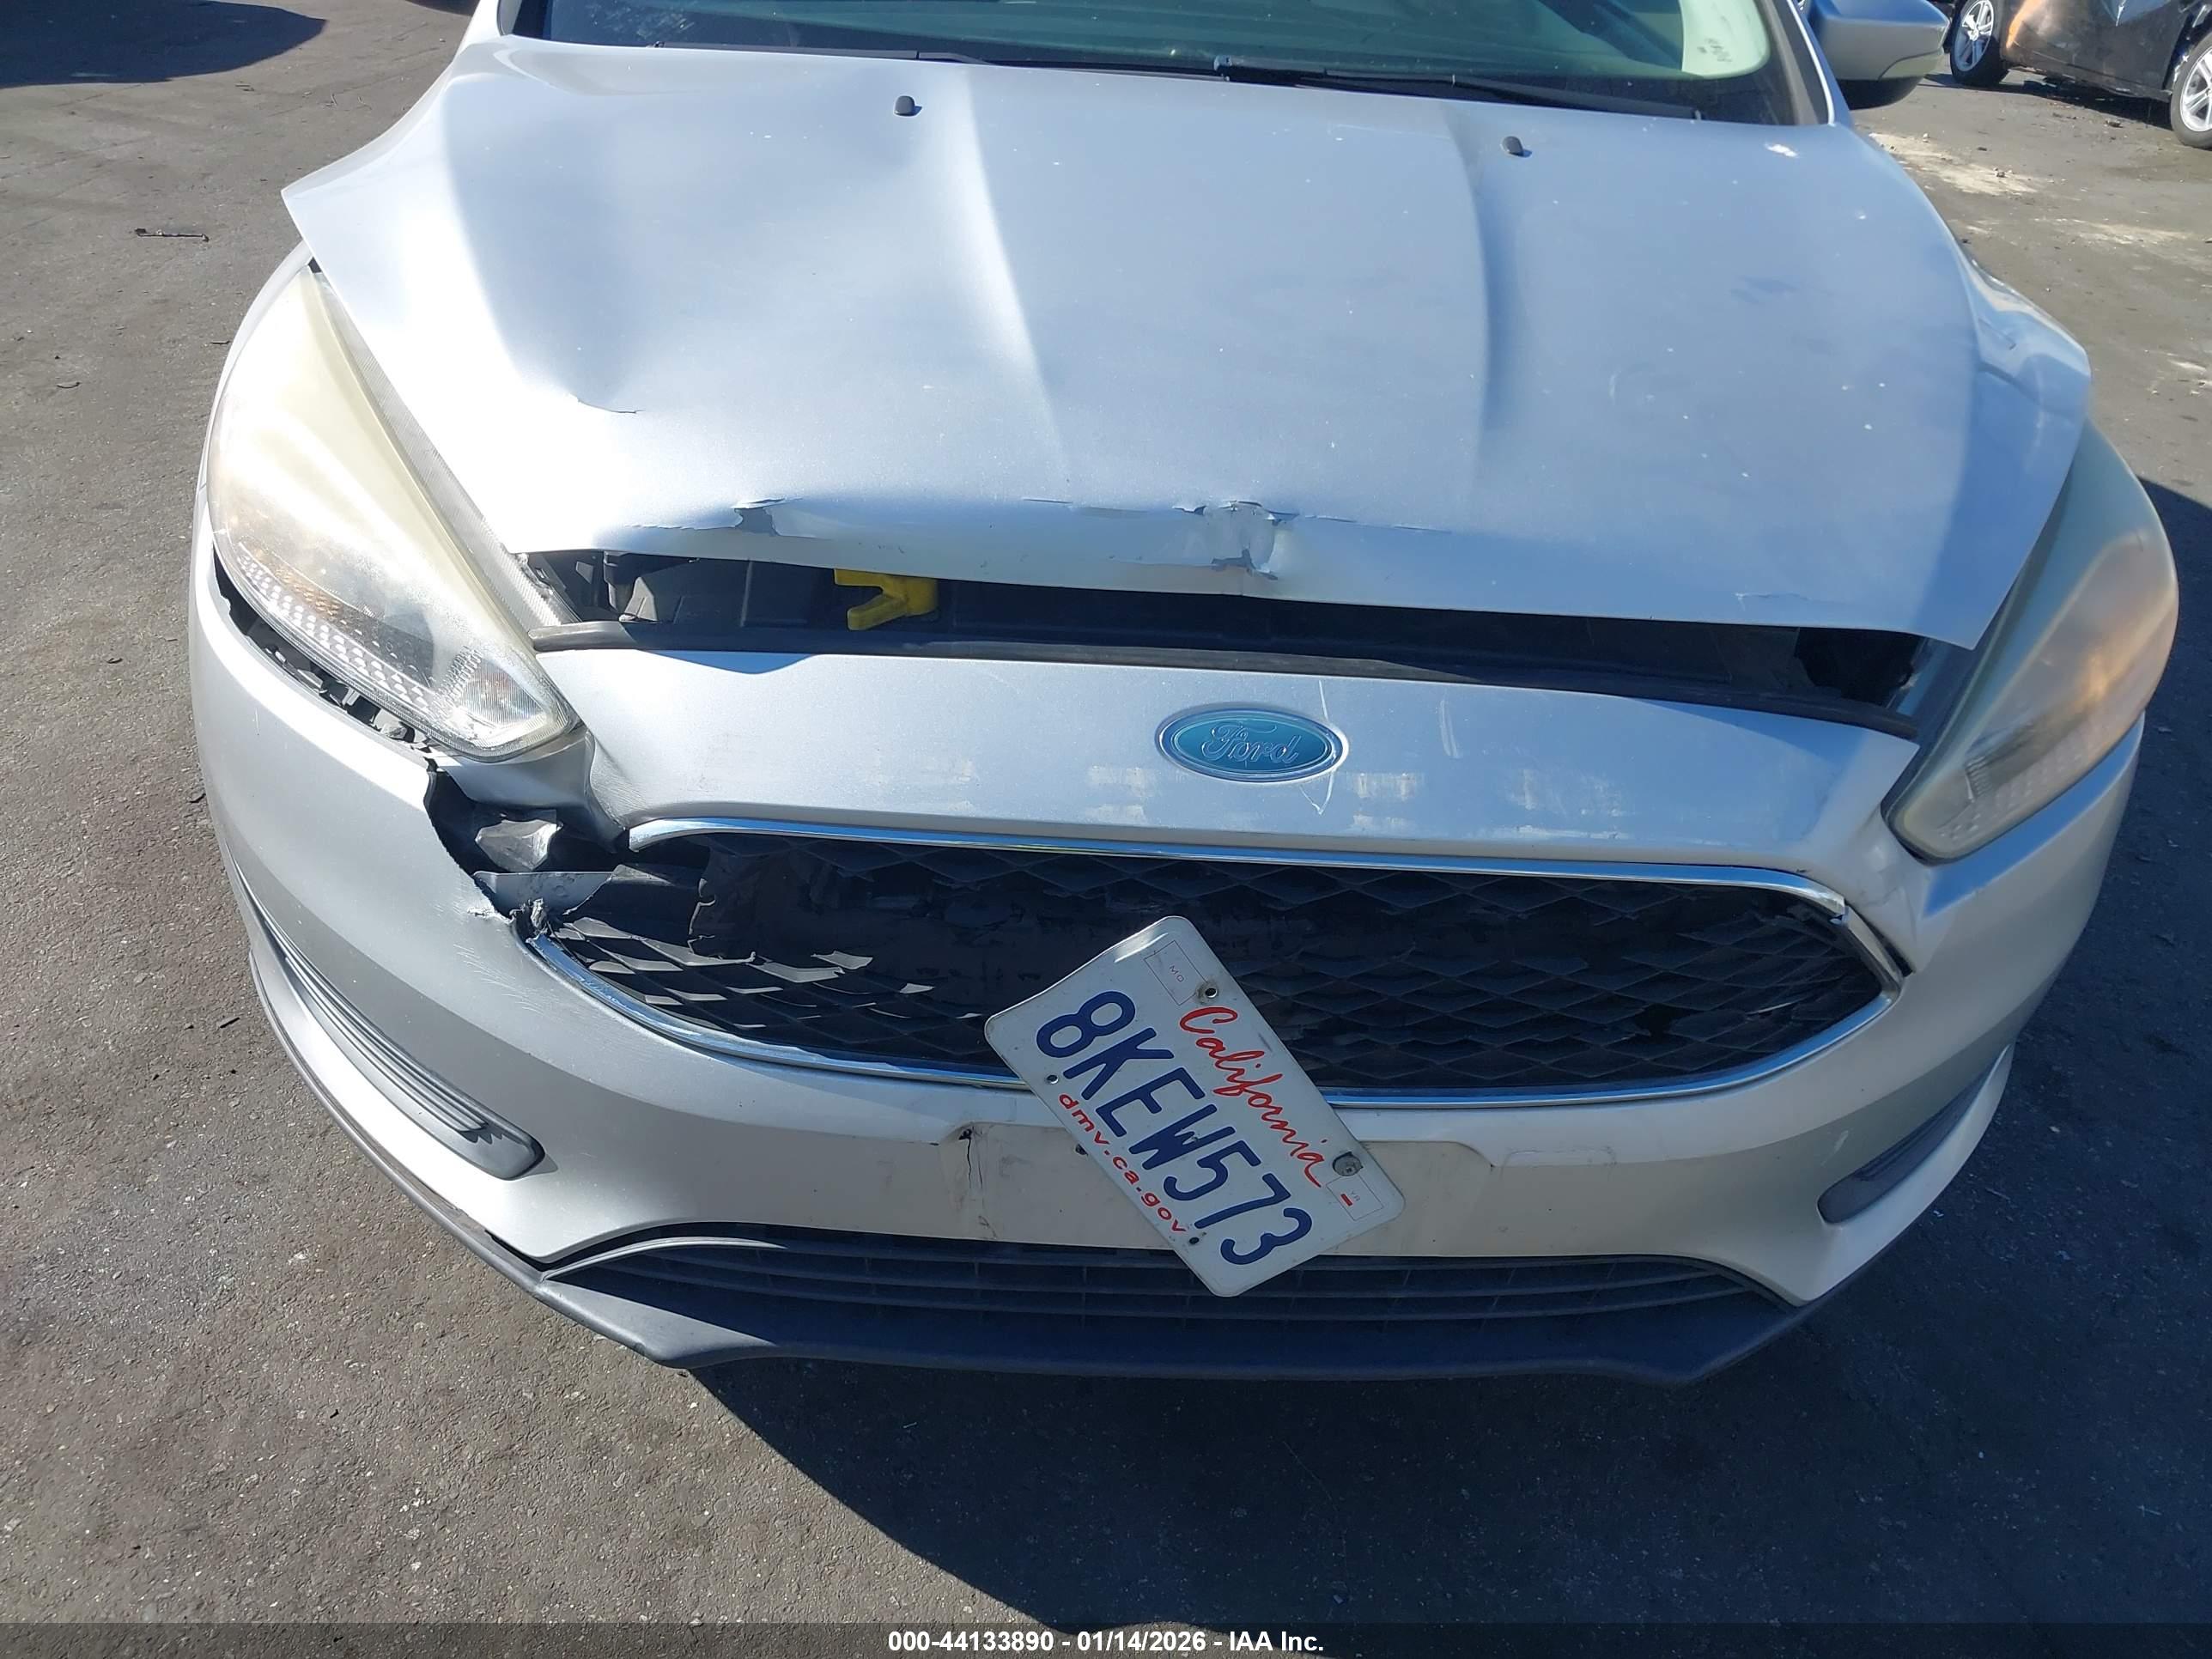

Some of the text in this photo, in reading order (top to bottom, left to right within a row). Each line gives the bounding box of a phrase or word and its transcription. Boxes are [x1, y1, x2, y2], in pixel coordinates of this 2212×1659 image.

[1201, 720, 1300, 763] Ford
[1169, 965, 1185, 982] MO
[1036, 990, 1313, 1266] 8KEW573
[1058, 1093, 1187, 1234] dmv.ca.gov
[1179, 1006, 1328, 1188] California
